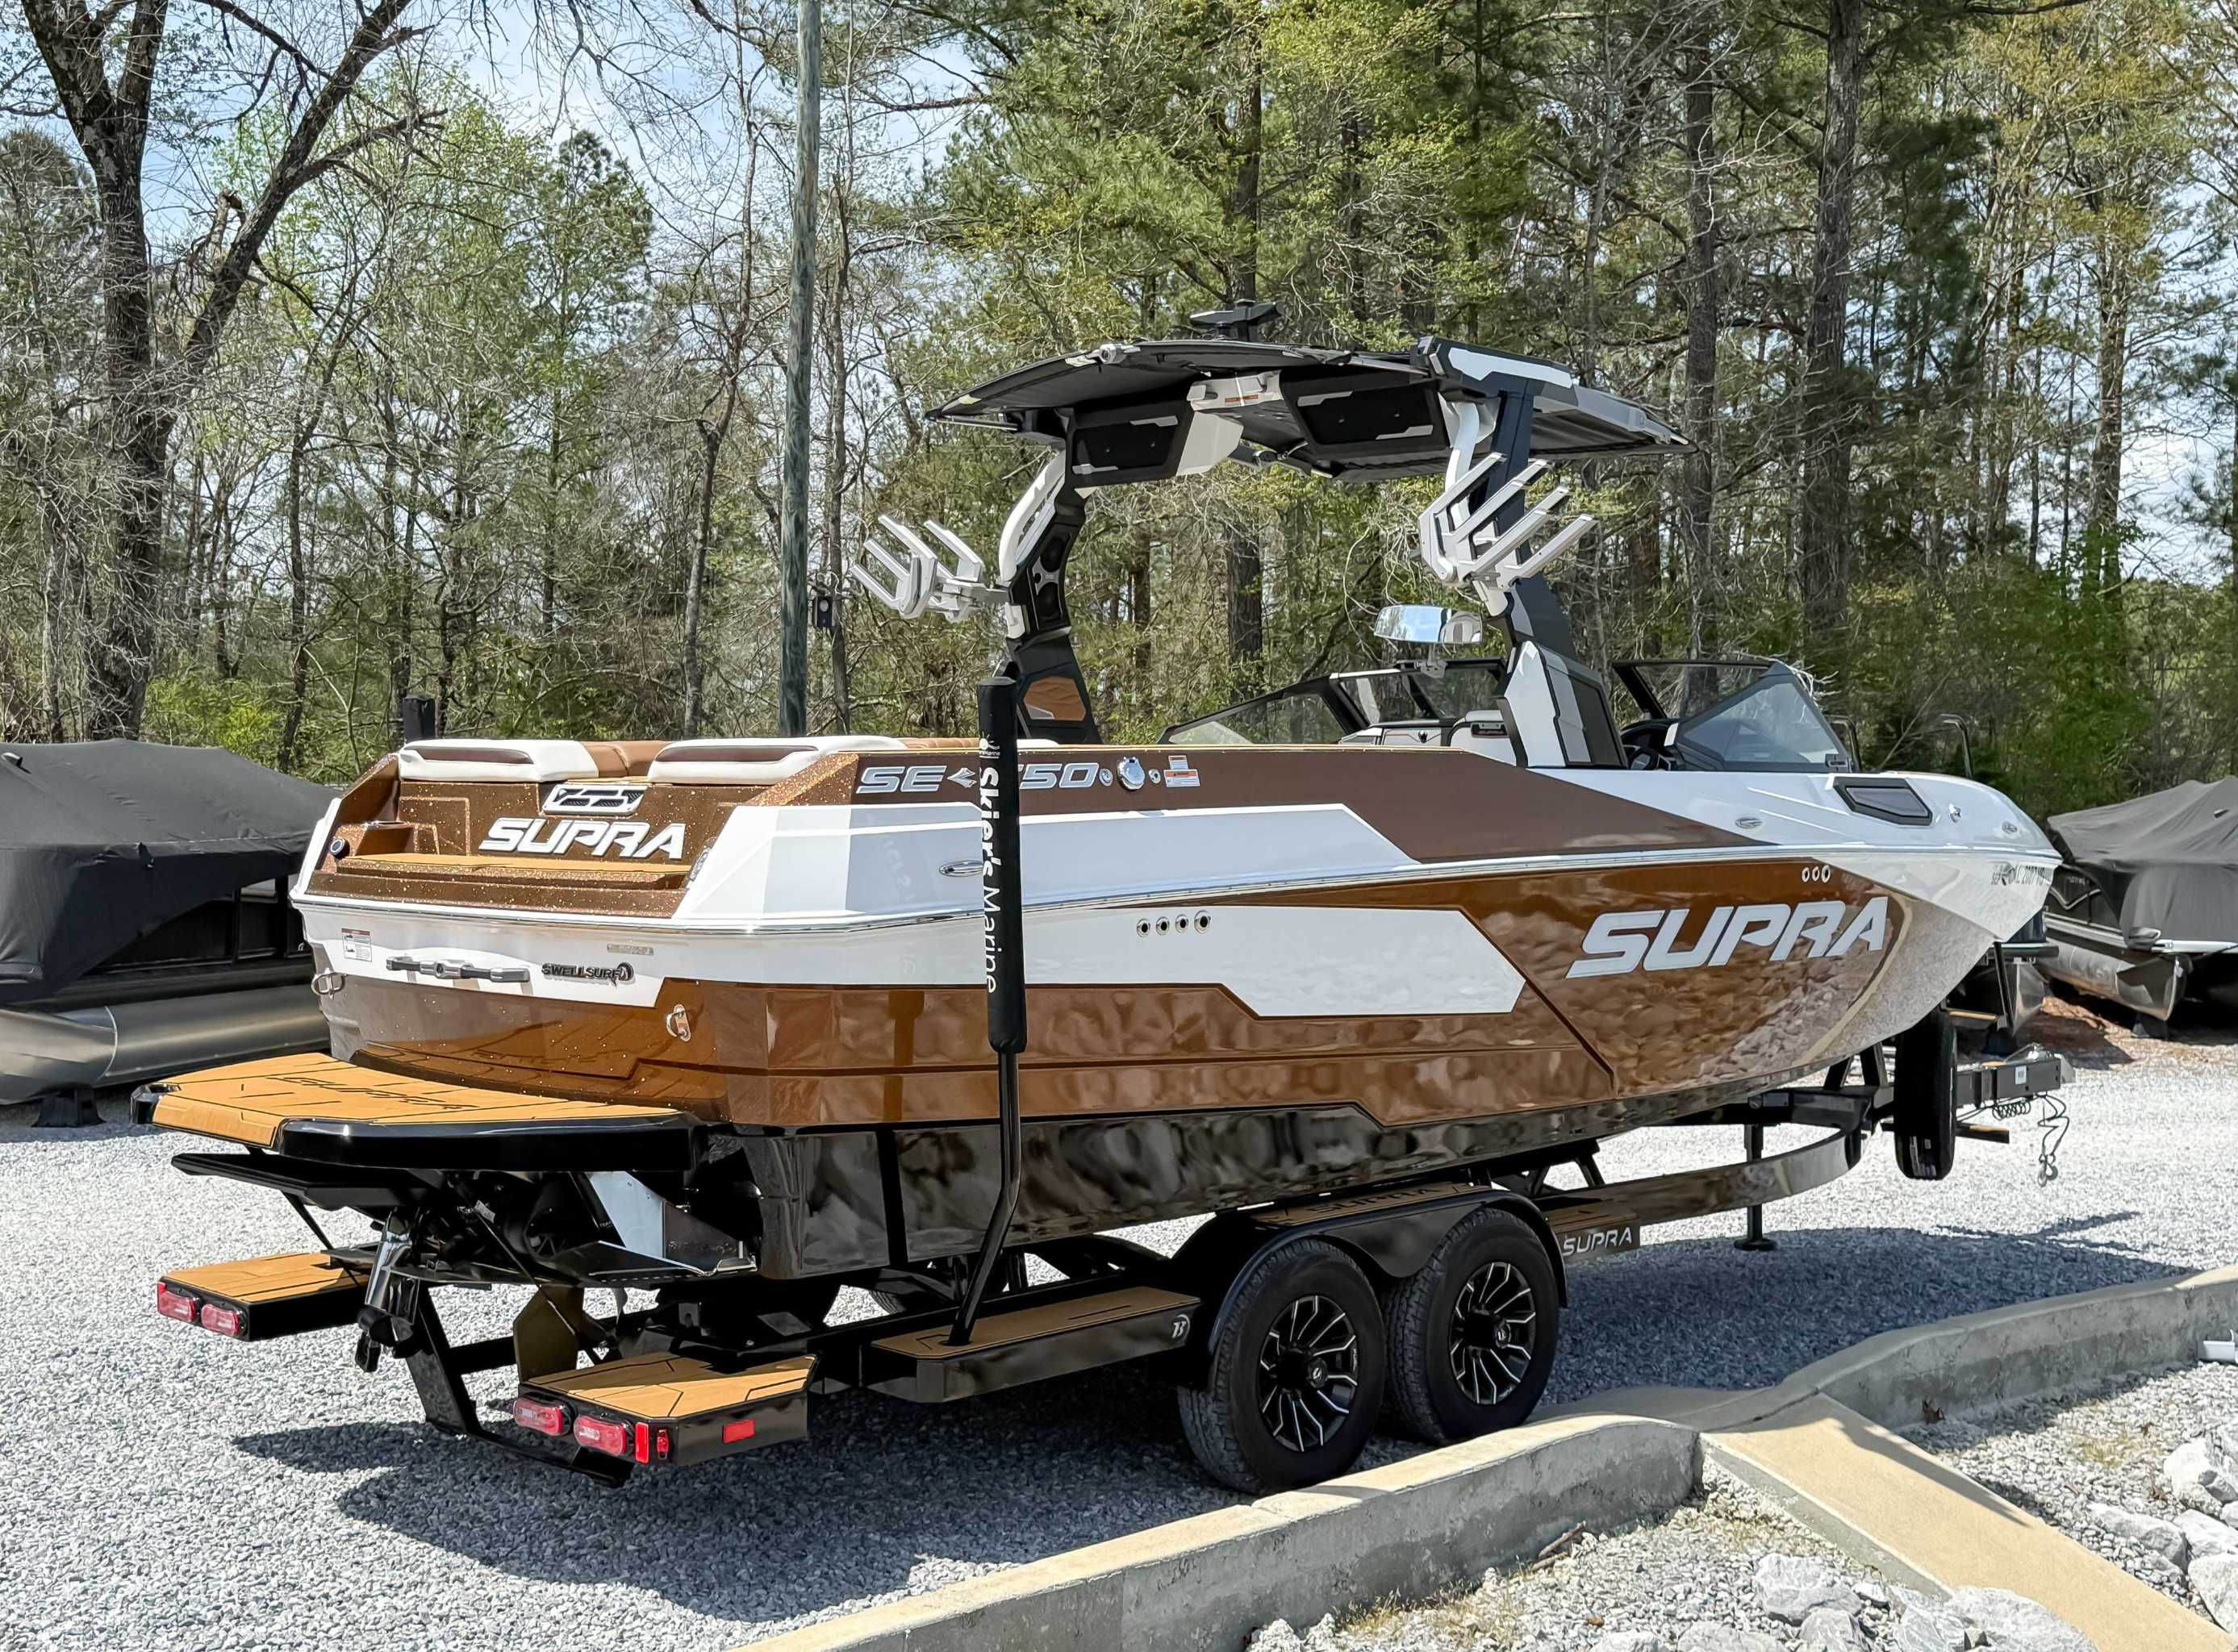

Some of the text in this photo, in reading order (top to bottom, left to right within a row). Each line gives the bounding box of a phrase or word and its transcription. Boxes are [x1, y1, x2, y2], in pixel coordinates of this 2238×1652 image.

[856, 762, 1100, 794] SE 50
[478, 817, 686, 859] SUPRA
[979, 767, 1001, 877] Skier's
[983, 888, 1002, 993] Marine
[1566, 896, 1888, 978] SUPRA
[1562, 1227, 1632, 1257] SUPRA
